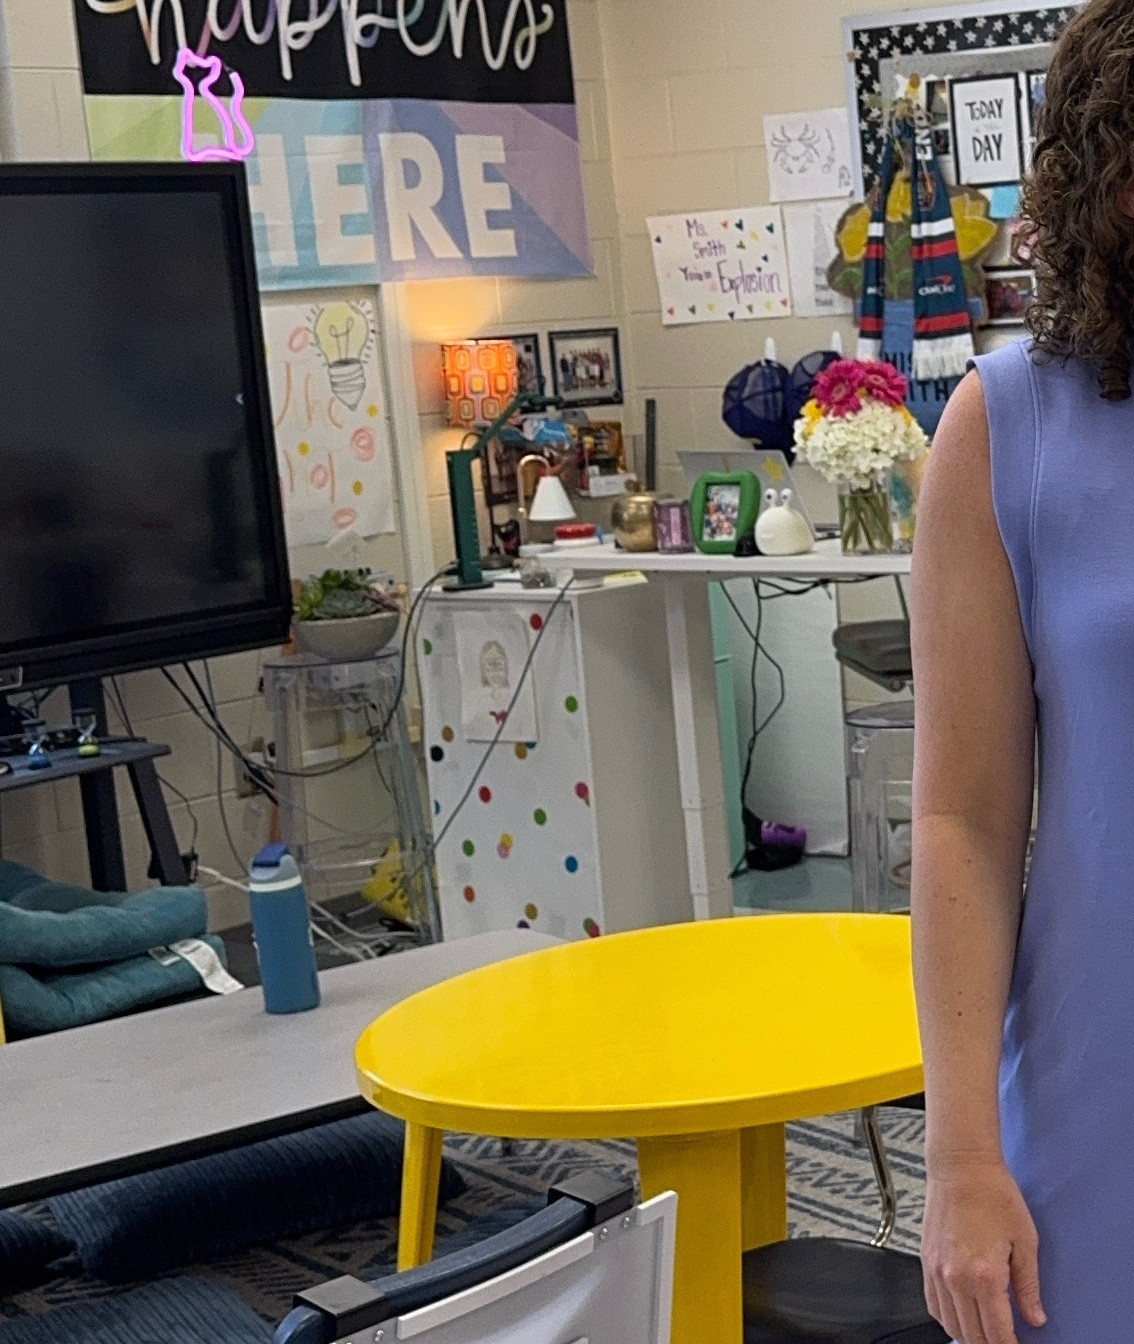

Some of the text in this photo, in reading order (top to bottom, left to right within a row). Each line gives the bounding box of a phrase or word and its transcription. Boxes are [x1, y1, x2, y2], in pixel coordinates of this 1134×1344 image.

[964, 98, 1004, 122] TODAY
[972, 133, 1003, 163] DAY
[193, 134, 518, 268] HERE
